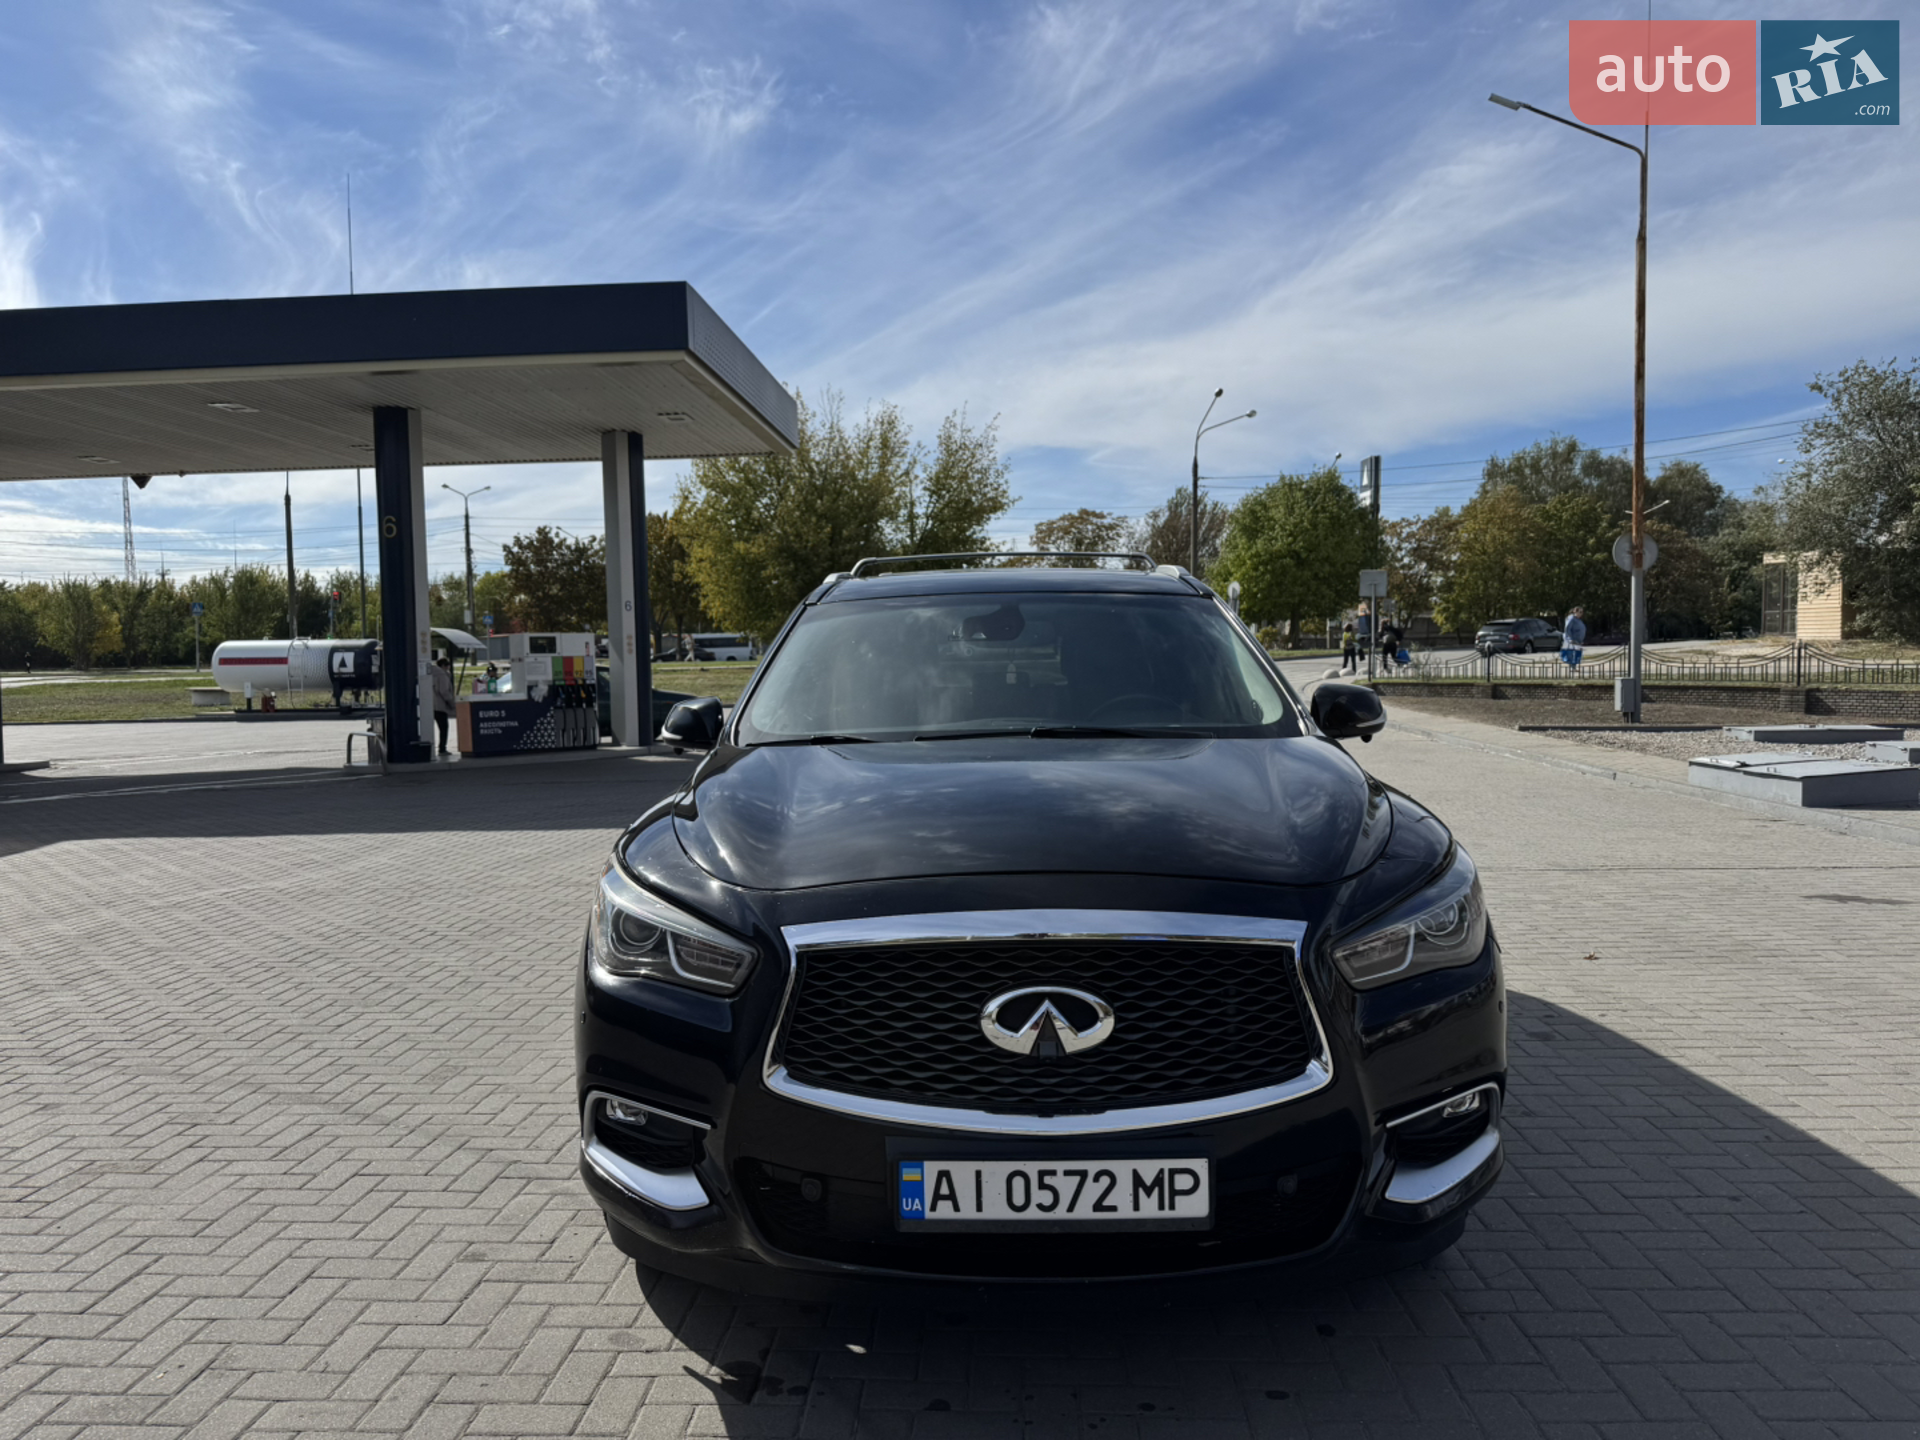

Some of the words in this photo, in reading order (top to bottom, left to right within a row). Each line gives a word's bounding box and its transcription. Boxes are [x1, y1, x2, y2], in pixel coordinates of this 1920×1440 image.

[383, 515, 397, 538] 6
[624, 600, 633, 612] 6
[479, 710, 500, 718] EURO
[501, 710, 506, 718] 5
[479, 720, 519, 728] АБСОЛЮТНА
[929, 1169, 983, 1213] AI
[1005, 1169, 1118, 1213] 0572
[1132, 1167, 1201, 1212] MP
[902, 1198, 922, 1212] UA
